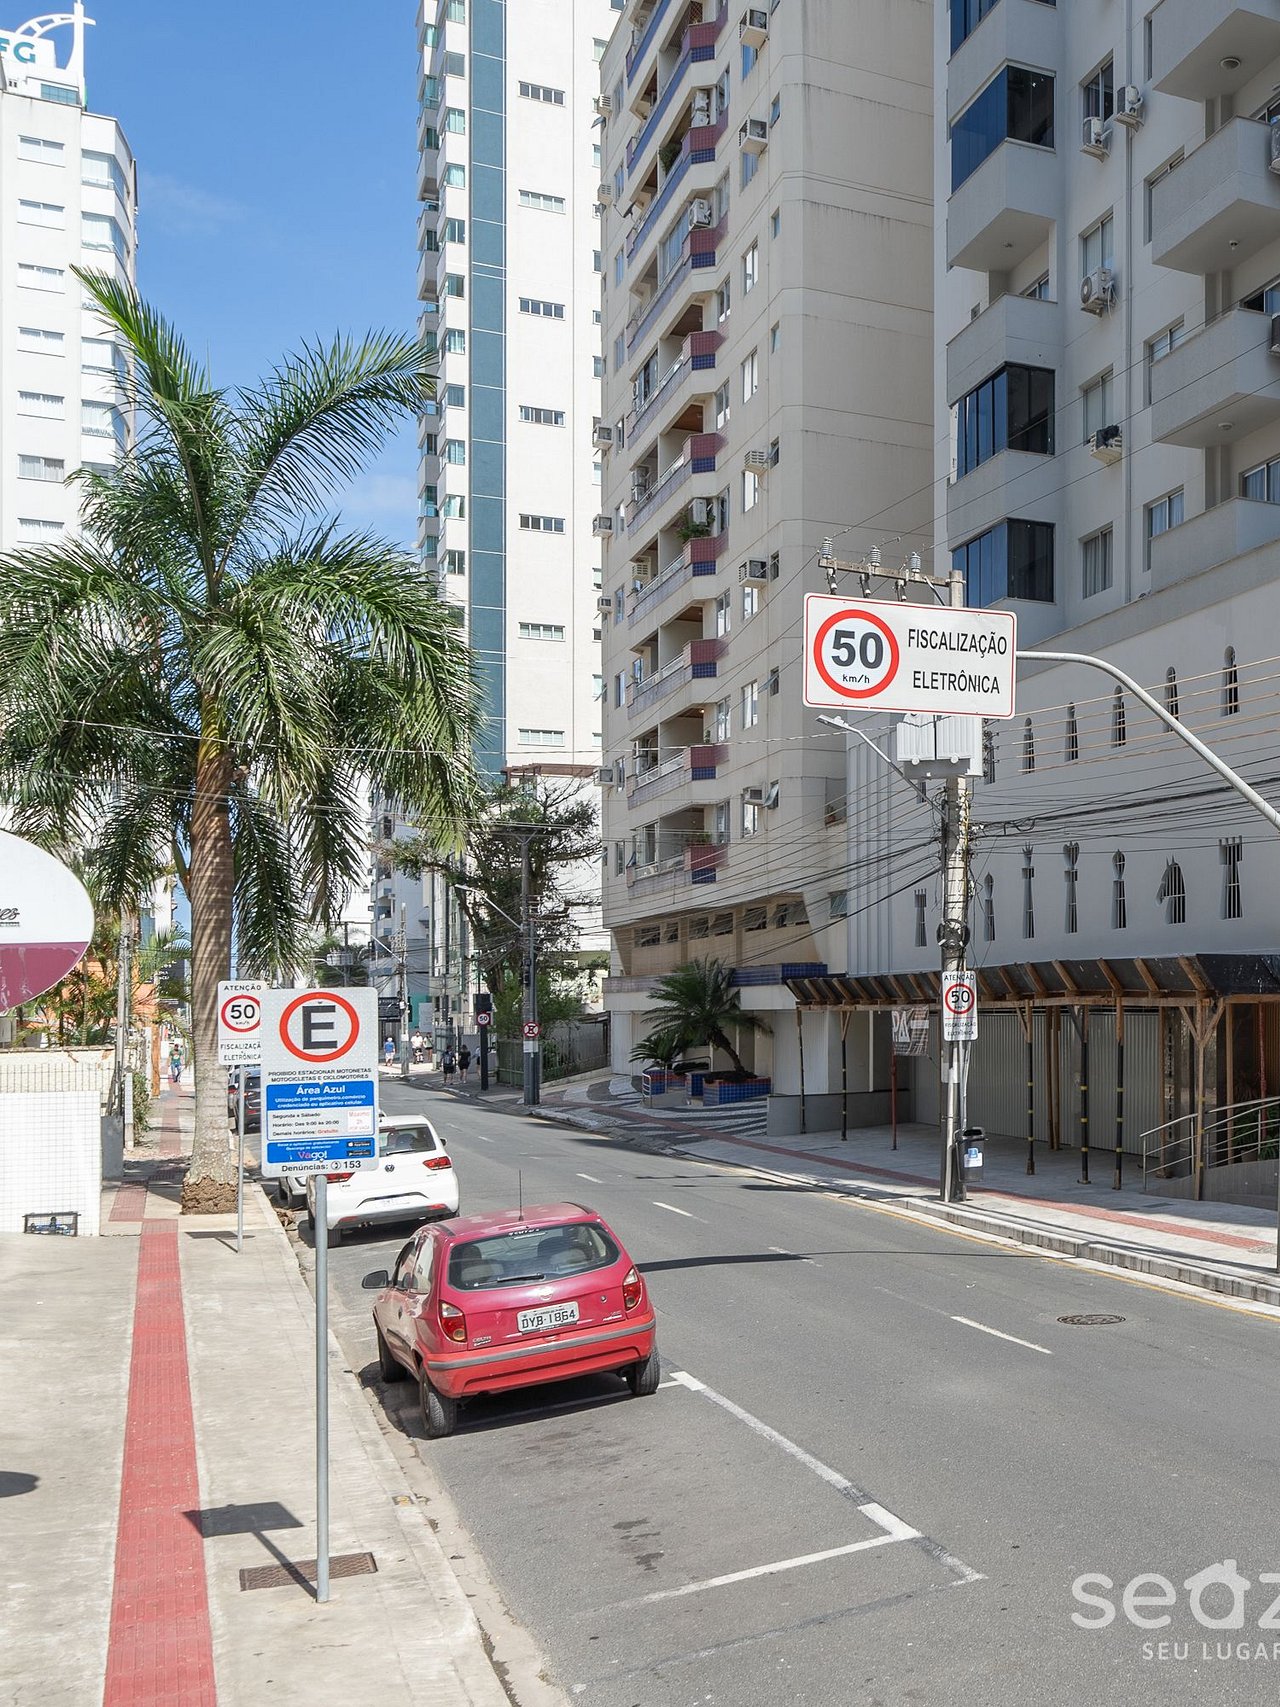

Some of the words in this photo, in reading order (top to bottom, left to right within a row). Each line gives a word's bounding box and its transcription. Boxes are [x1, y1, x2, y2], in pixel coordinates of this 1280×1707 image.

[832, 630, 884, 669] 50
[908, 629, 1006, 658] FISCALIZAÇÃO
[842, 674, 870, 684] km/h
[913, 670, 1000, 694] ELETRÔNICA
[944, 972, 974, 982] ATENÇÃO
[952, 990, 970, 1003] 50
[230, 1004, 255, 1019] 50
[302, 1005, 338, 1050] E
[296, 1085, 320, 1094] Área
[323, 1085, 345, 1094] Azul
[282, 1164, 328, 1172] Denúncias:
[344, 1161, 361, 1169] 153
